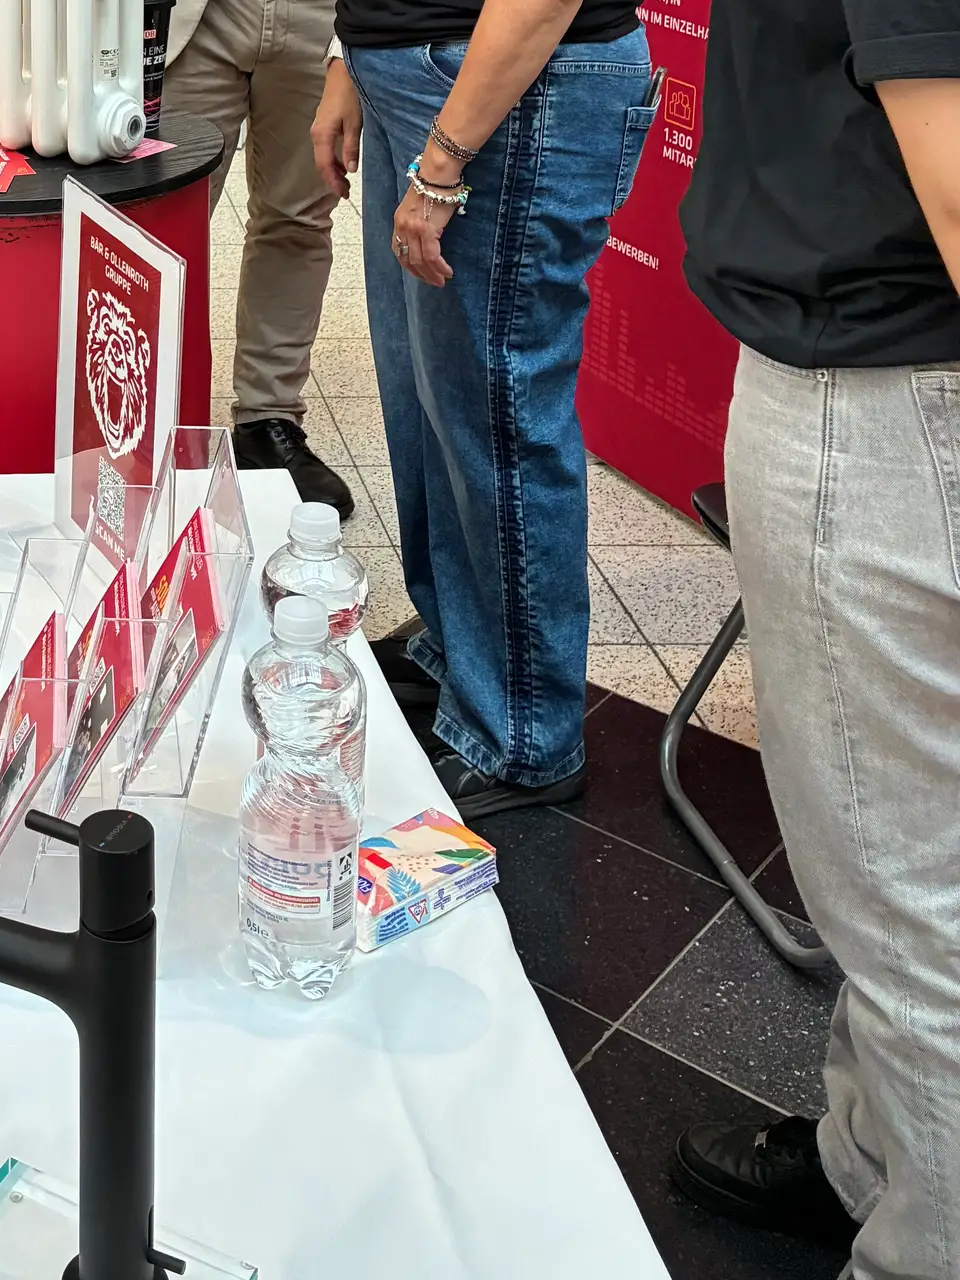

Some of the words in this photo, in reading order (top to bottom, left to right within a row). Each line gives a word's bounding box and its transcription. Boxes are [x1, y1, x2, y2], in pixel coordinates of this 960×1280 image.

[650, 11, 662, 26] IM
[149, 44, 164, 56] EINE
[664, 127, 693, 151] 1.300
[662, 145, 696, 170] MITAR
[90, 235, 104, 257] BÄR
[110, 251, 149, 293] OLLENROTH
[105, 265, 131, 296] GRUPPE
[96, 521, 113, 549] SCAN
